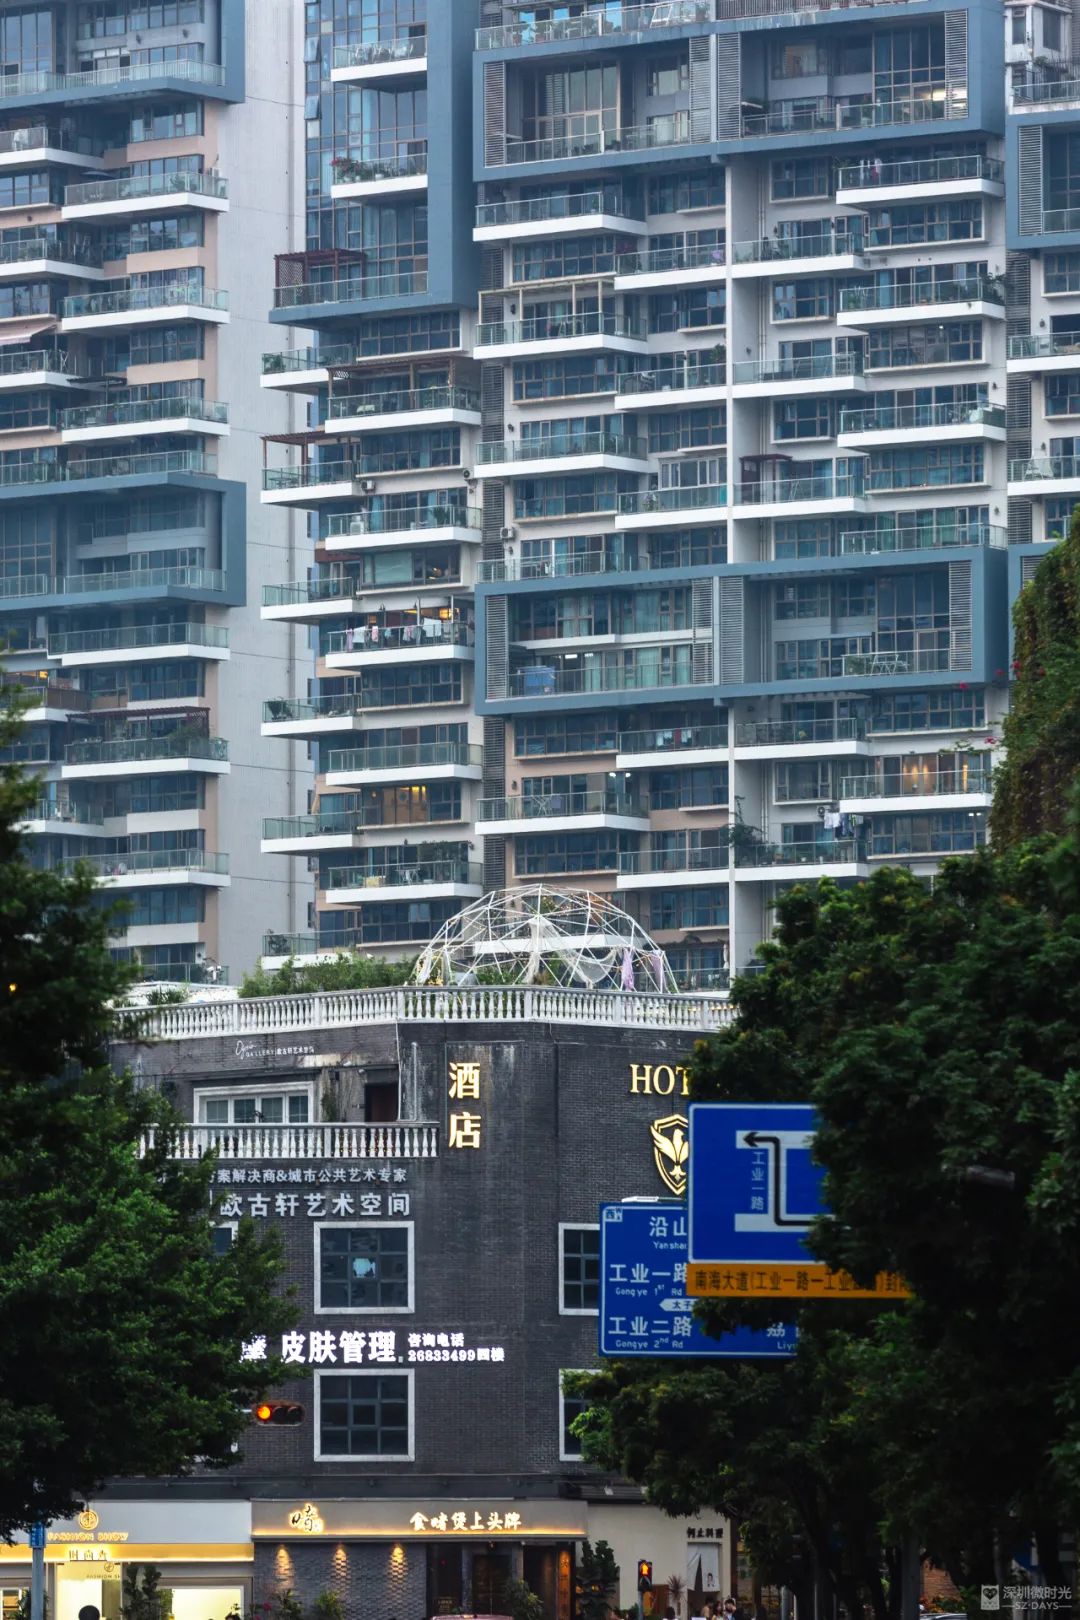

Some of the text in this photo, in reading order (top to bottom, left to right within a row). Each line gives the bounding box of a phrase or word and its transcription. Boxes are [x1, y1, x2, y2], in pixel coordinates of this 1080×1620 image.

[448, 1062, 481, 1149] 酒店
[752, 1151, 765, 1211] 工业一路
[220, 1192, 410, 1217] 欧古轩艺术空间
[609, 1263, 687, 1283] 工业一路
[671, 1288, 682, 1296] Rd
[608, 1316, 692, 1336] 工业二路
[281, 1331, 397, 1363] 皮肤管理
[408, 1332, 465, 1347] 咨询电话
[672, 1341, 684, 1349] Rd
